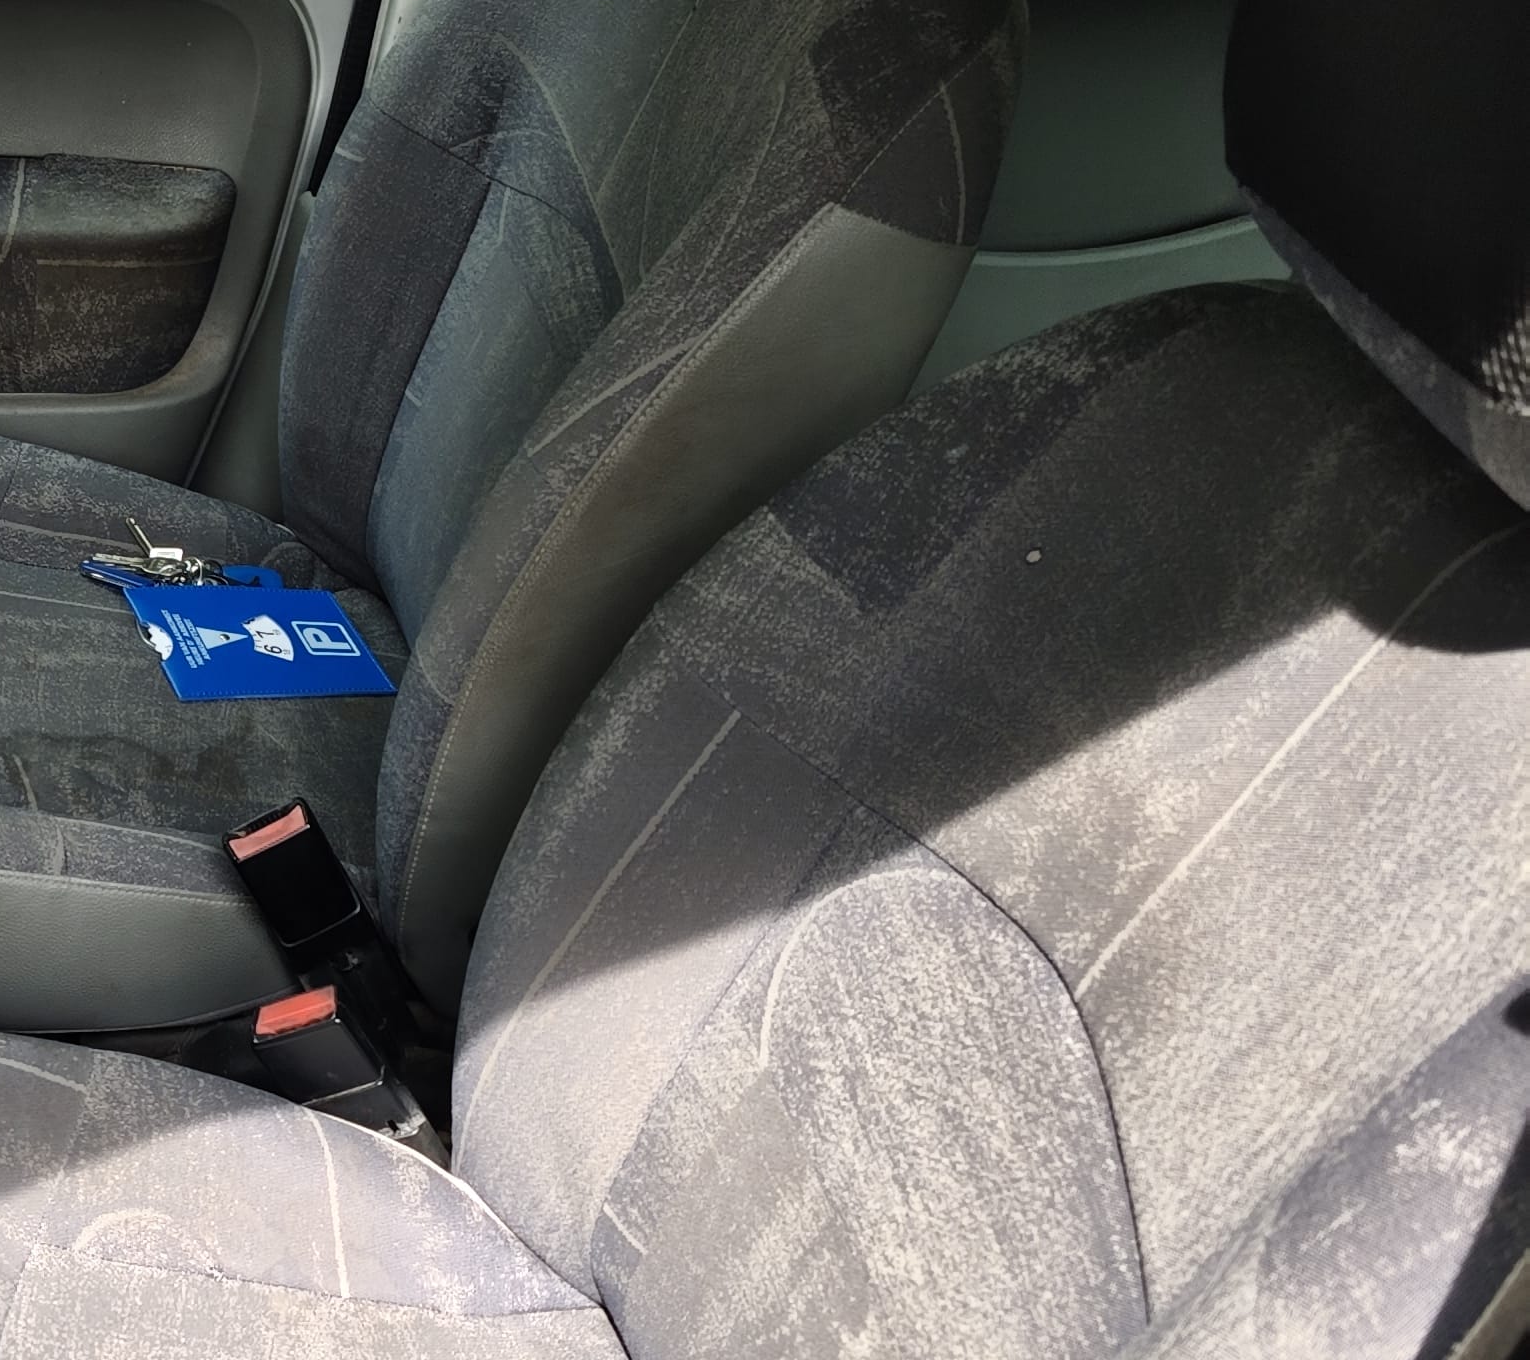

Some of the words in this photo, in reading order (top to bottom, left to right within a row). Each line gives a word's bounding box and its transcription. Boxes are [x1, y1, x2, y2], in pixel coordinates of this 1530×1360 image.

[255, 628, 275, 639] 7
[303, 627, 352, 651] P
[264, 644, 283, 655] 6
